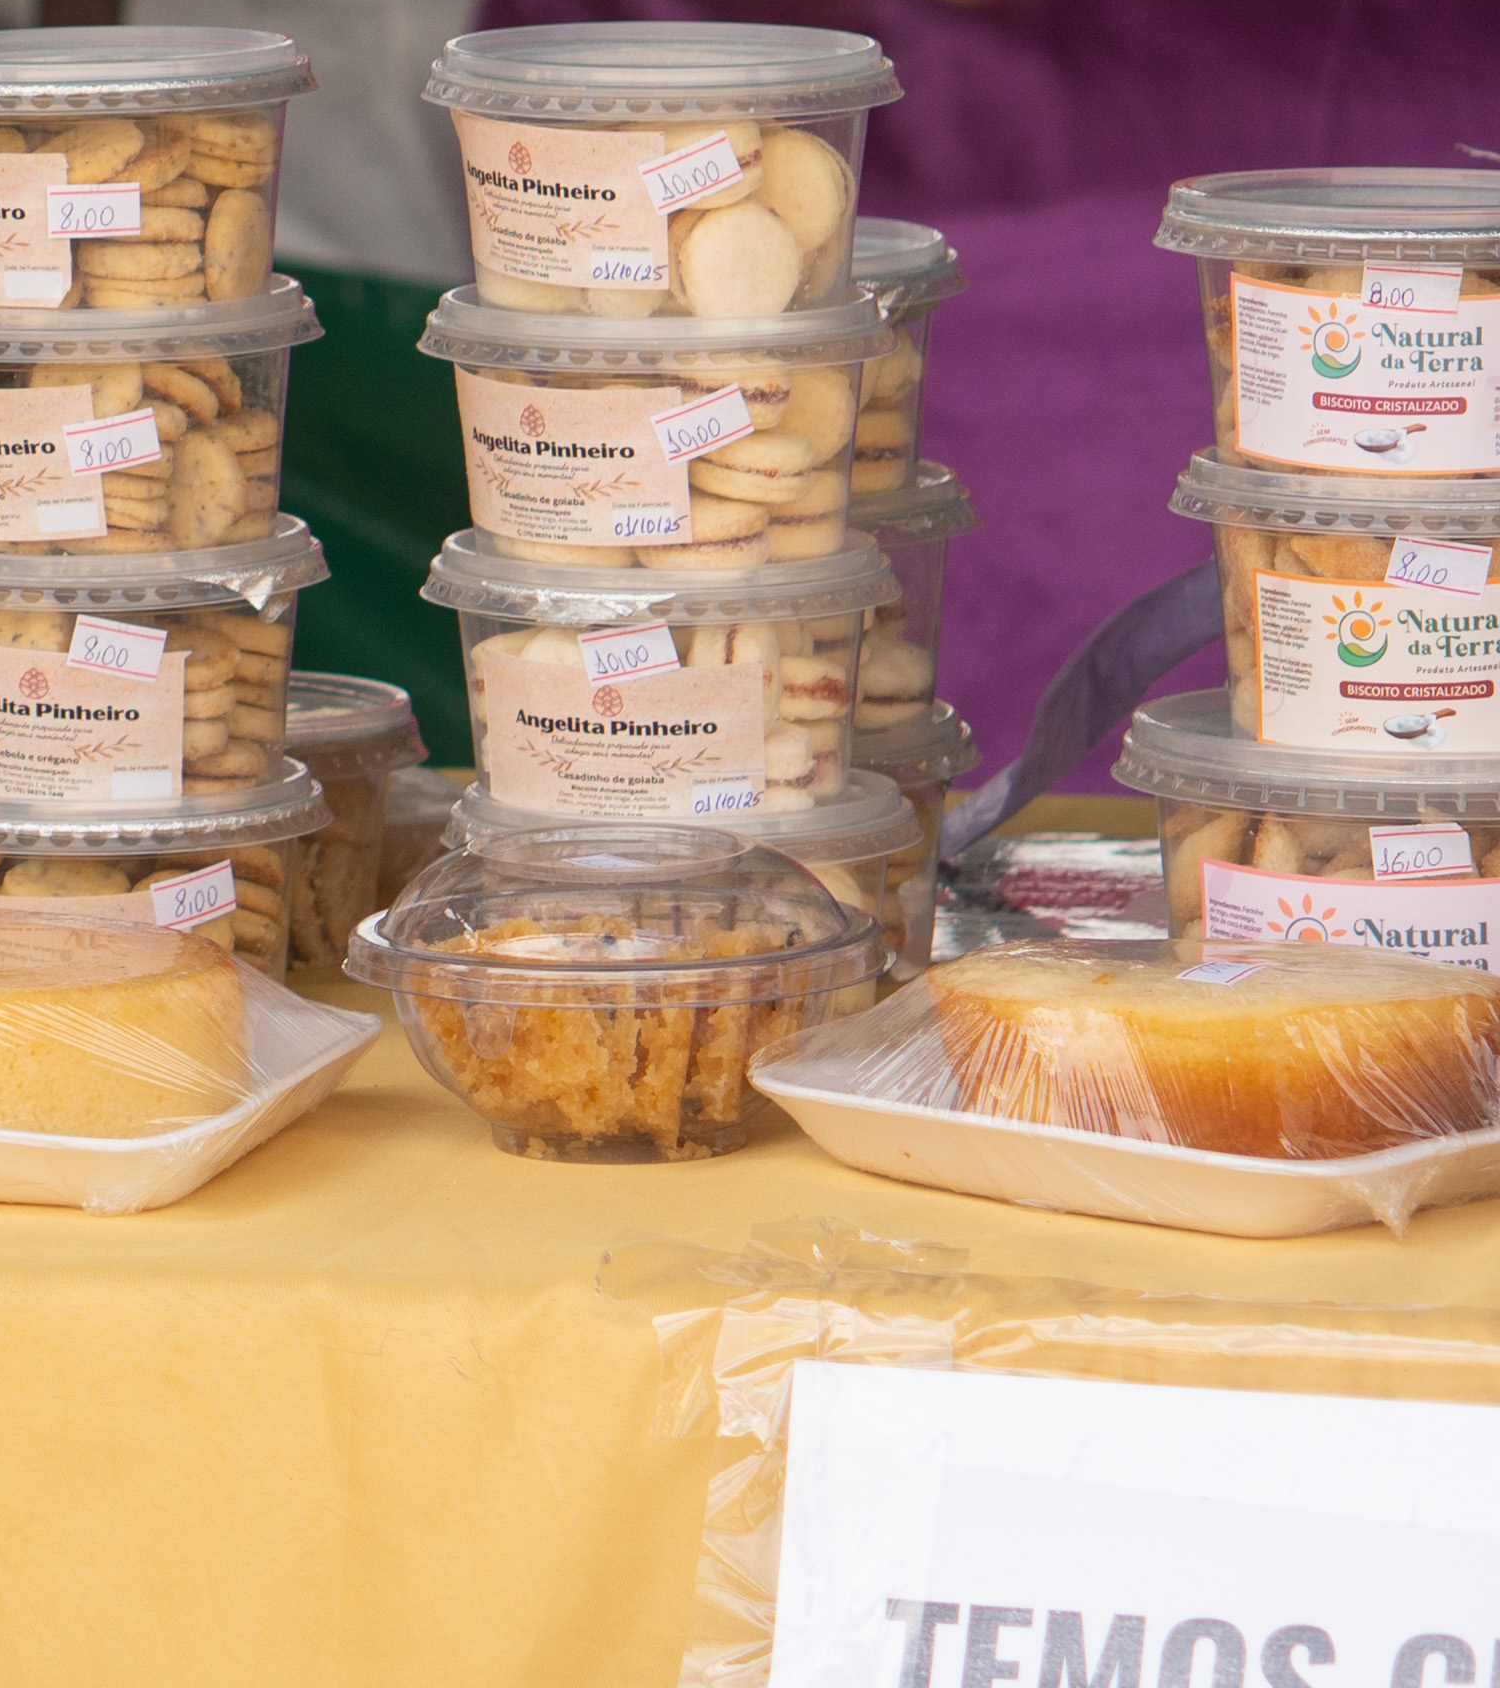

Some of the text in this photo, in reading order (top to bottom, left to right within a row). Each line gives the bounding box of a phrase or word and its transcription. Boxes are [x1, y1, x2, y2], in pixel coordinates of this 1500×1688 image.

[523, 178, 616, 201] Pinheiro
[60, 202, 115, 232] 8,00
[1369, 281, 1415, 308] 8,00
[1372, 322, 1483, 348] Natural
[1381, 350, 1483, 373] da Terra
[1388, 379, 1475, 388] Produto Artesanal
[1320, 395, 1459, 412] BISCOITO CRISTALIZADO
[79, 438, 133, 467] 8,00
[473, 427, 635, 459] Angelita Pinheiro
[1395, 551, 1448, 585] 8,00
[1397, 610, 1500, 633] Natura
[83, 635, 129, 669] 8,00
[1408, 640, 1432, 655] da
[1347, 683, 1487, 697] BISCOITO CRISTALIZADO
[35, 703, 139, 721] Pinheiro
[516, 709, 717, 736] Angelita Pinheiro
[558, 770, 664, 785] Casadinho de goiaba
[1378, 846, 1444, 874] 16,00
[174, 885, 218, 918] 8,00
[1353, 918, 1489, 948] Natural
